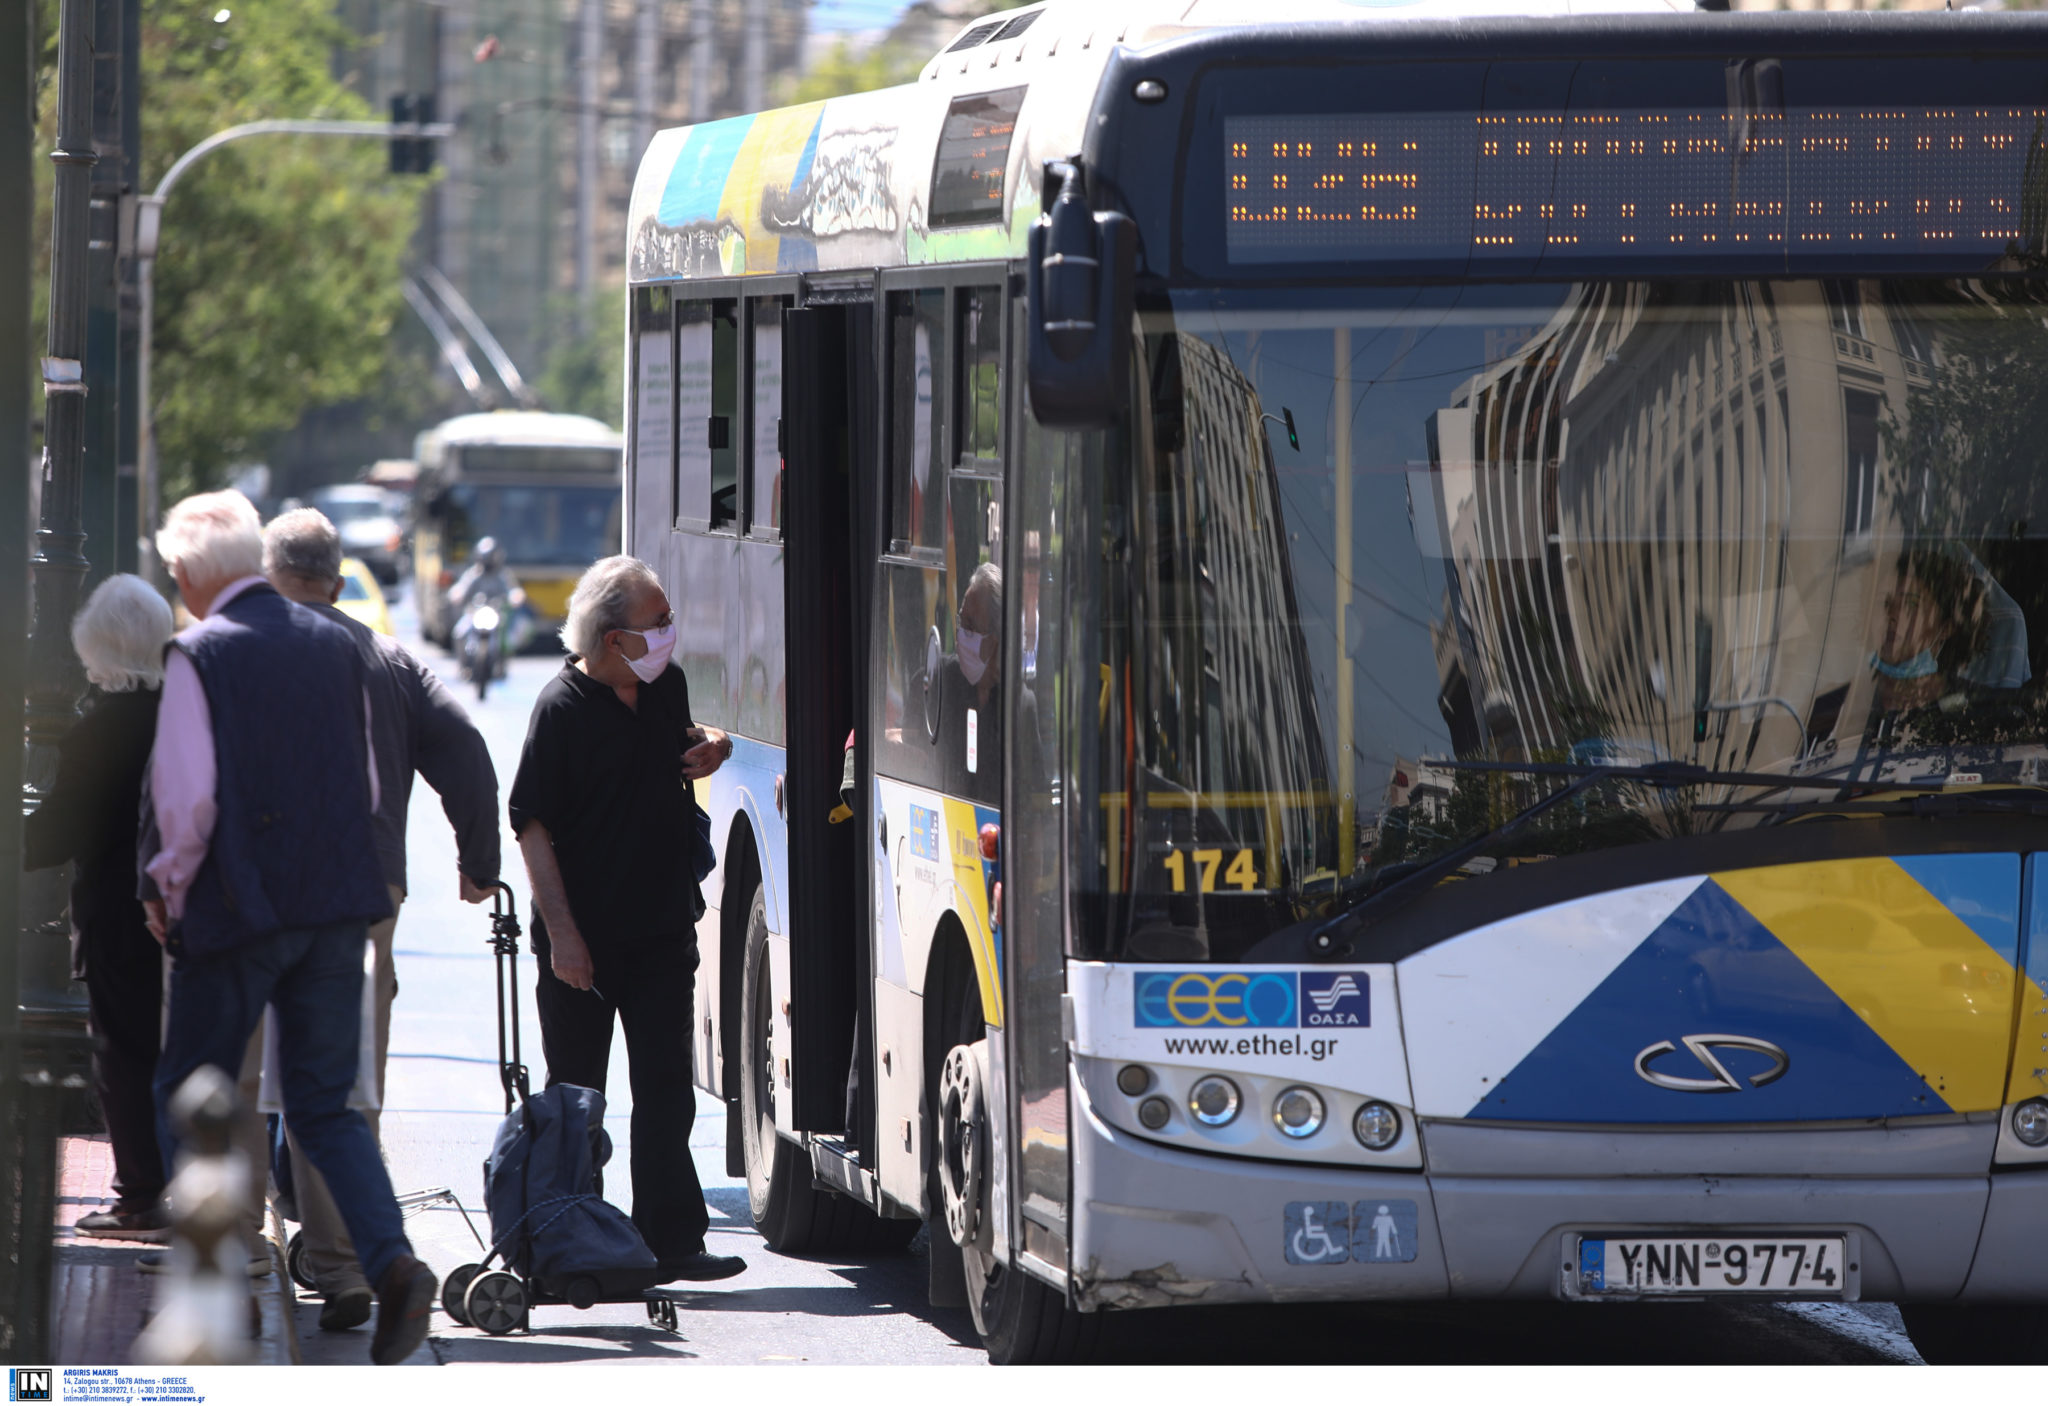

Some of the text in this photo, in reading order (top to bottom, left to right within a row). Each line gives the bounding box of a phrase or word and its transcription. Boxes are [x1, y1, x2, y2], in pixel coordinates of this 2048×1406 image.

[1163, 848, 1258, 893] 174
[1308, 1012, 1359, 1026] ΟΑΣΑ
[1164, 1033, 1339, 1061] www.ethel.gr
